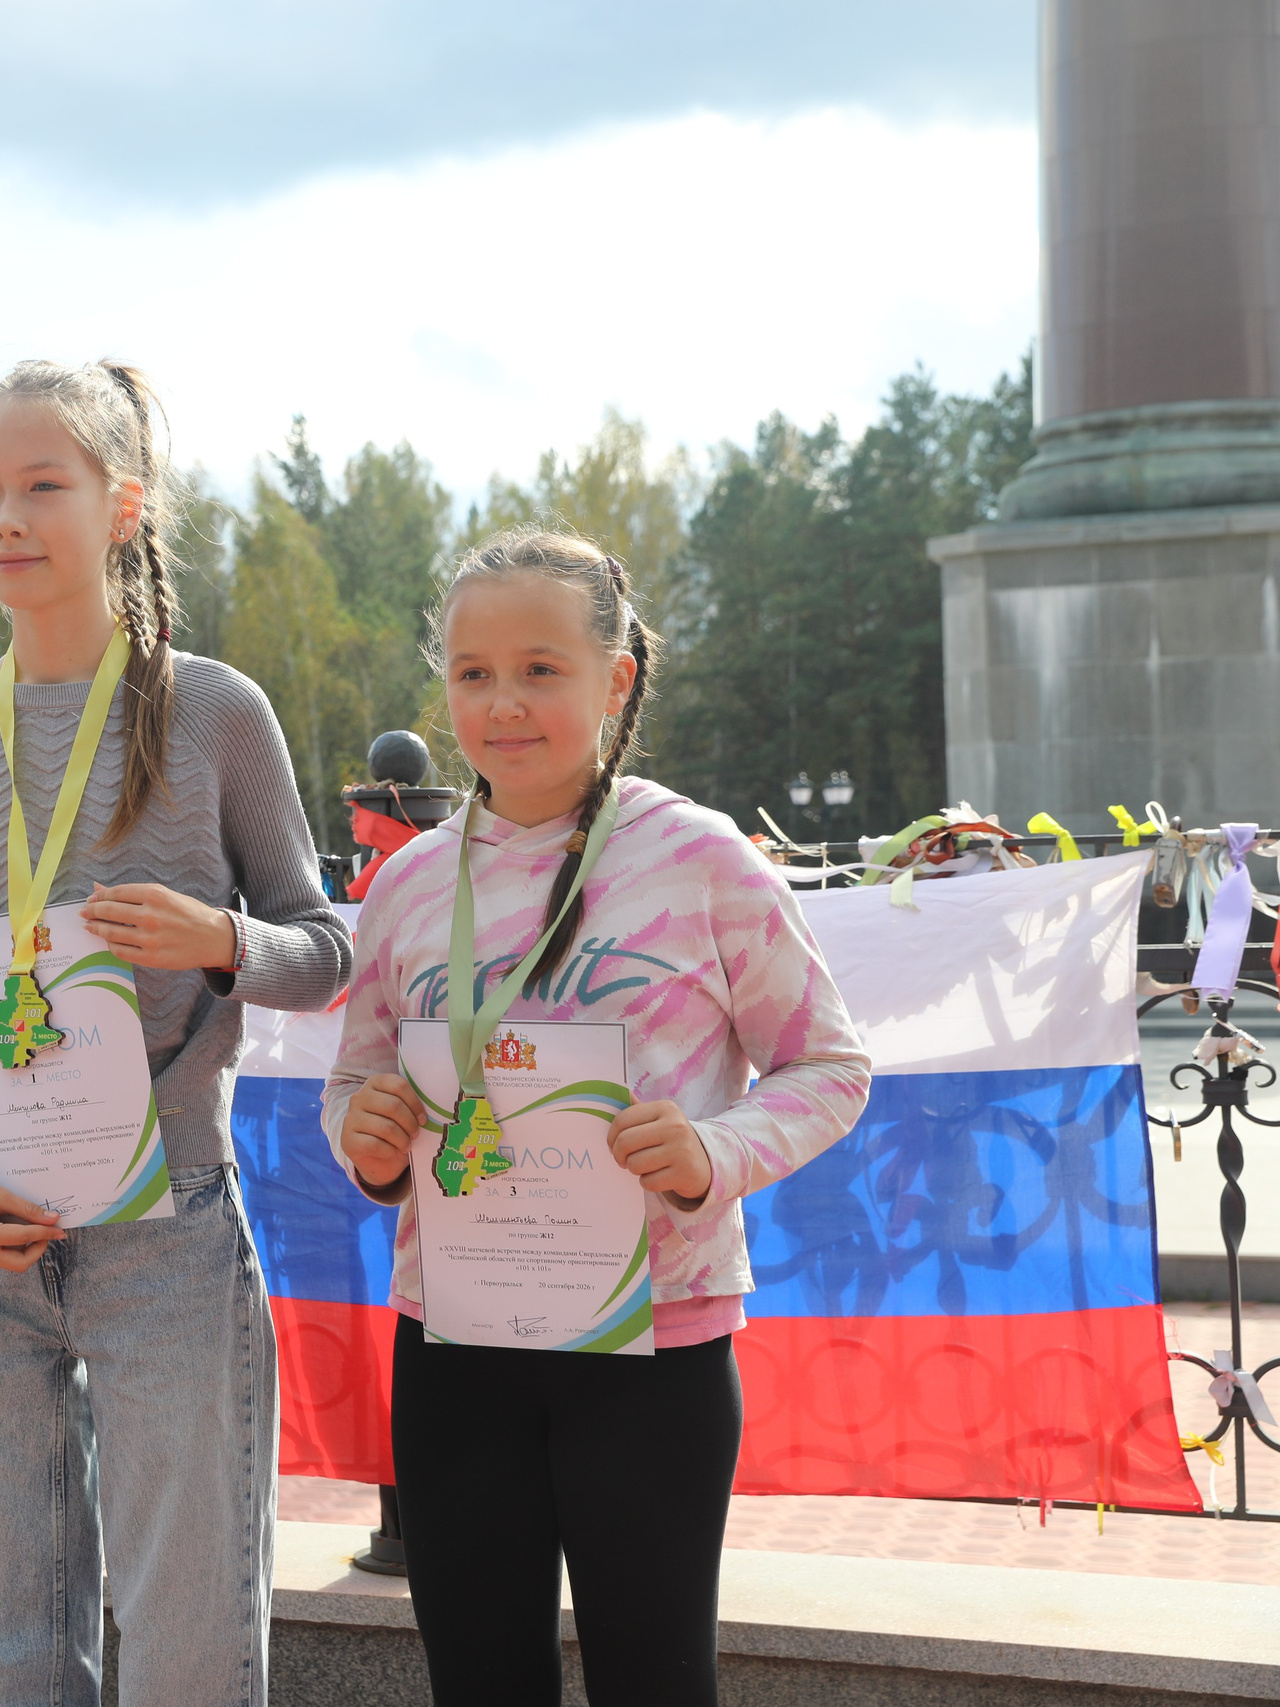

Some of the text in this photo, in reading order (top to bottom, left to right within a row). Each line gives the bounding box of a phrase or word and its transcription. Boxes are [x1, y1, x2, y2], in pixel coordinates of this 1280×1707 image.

[25, 1008, 42, 1018] 101
[10, 1069, 81, 1087] ЗА 1 МЕСТО
[95, 1123, 135, 1132] Свердловской
[49, 1138, 85, 1147] спортивному
[86, 1132, 134, 1143] ориентированию
[477, 1134, 495, 1144] 101
[498, 1146, 593, 1170] ПЛОМ
[12, 1167, 48, 1175] Первоуральск
[71, 1160, 95, 1168] сентября
[446, 1160, 465, 1171] 101
[485, 1186, 569, 1199] ЗА 3 МЕСТО
[578, 1250, 623, 1258] Свердловской
[480, 1279, 523, 1287] Первоуральск
[547, 1282, 575, 1290] сентября
